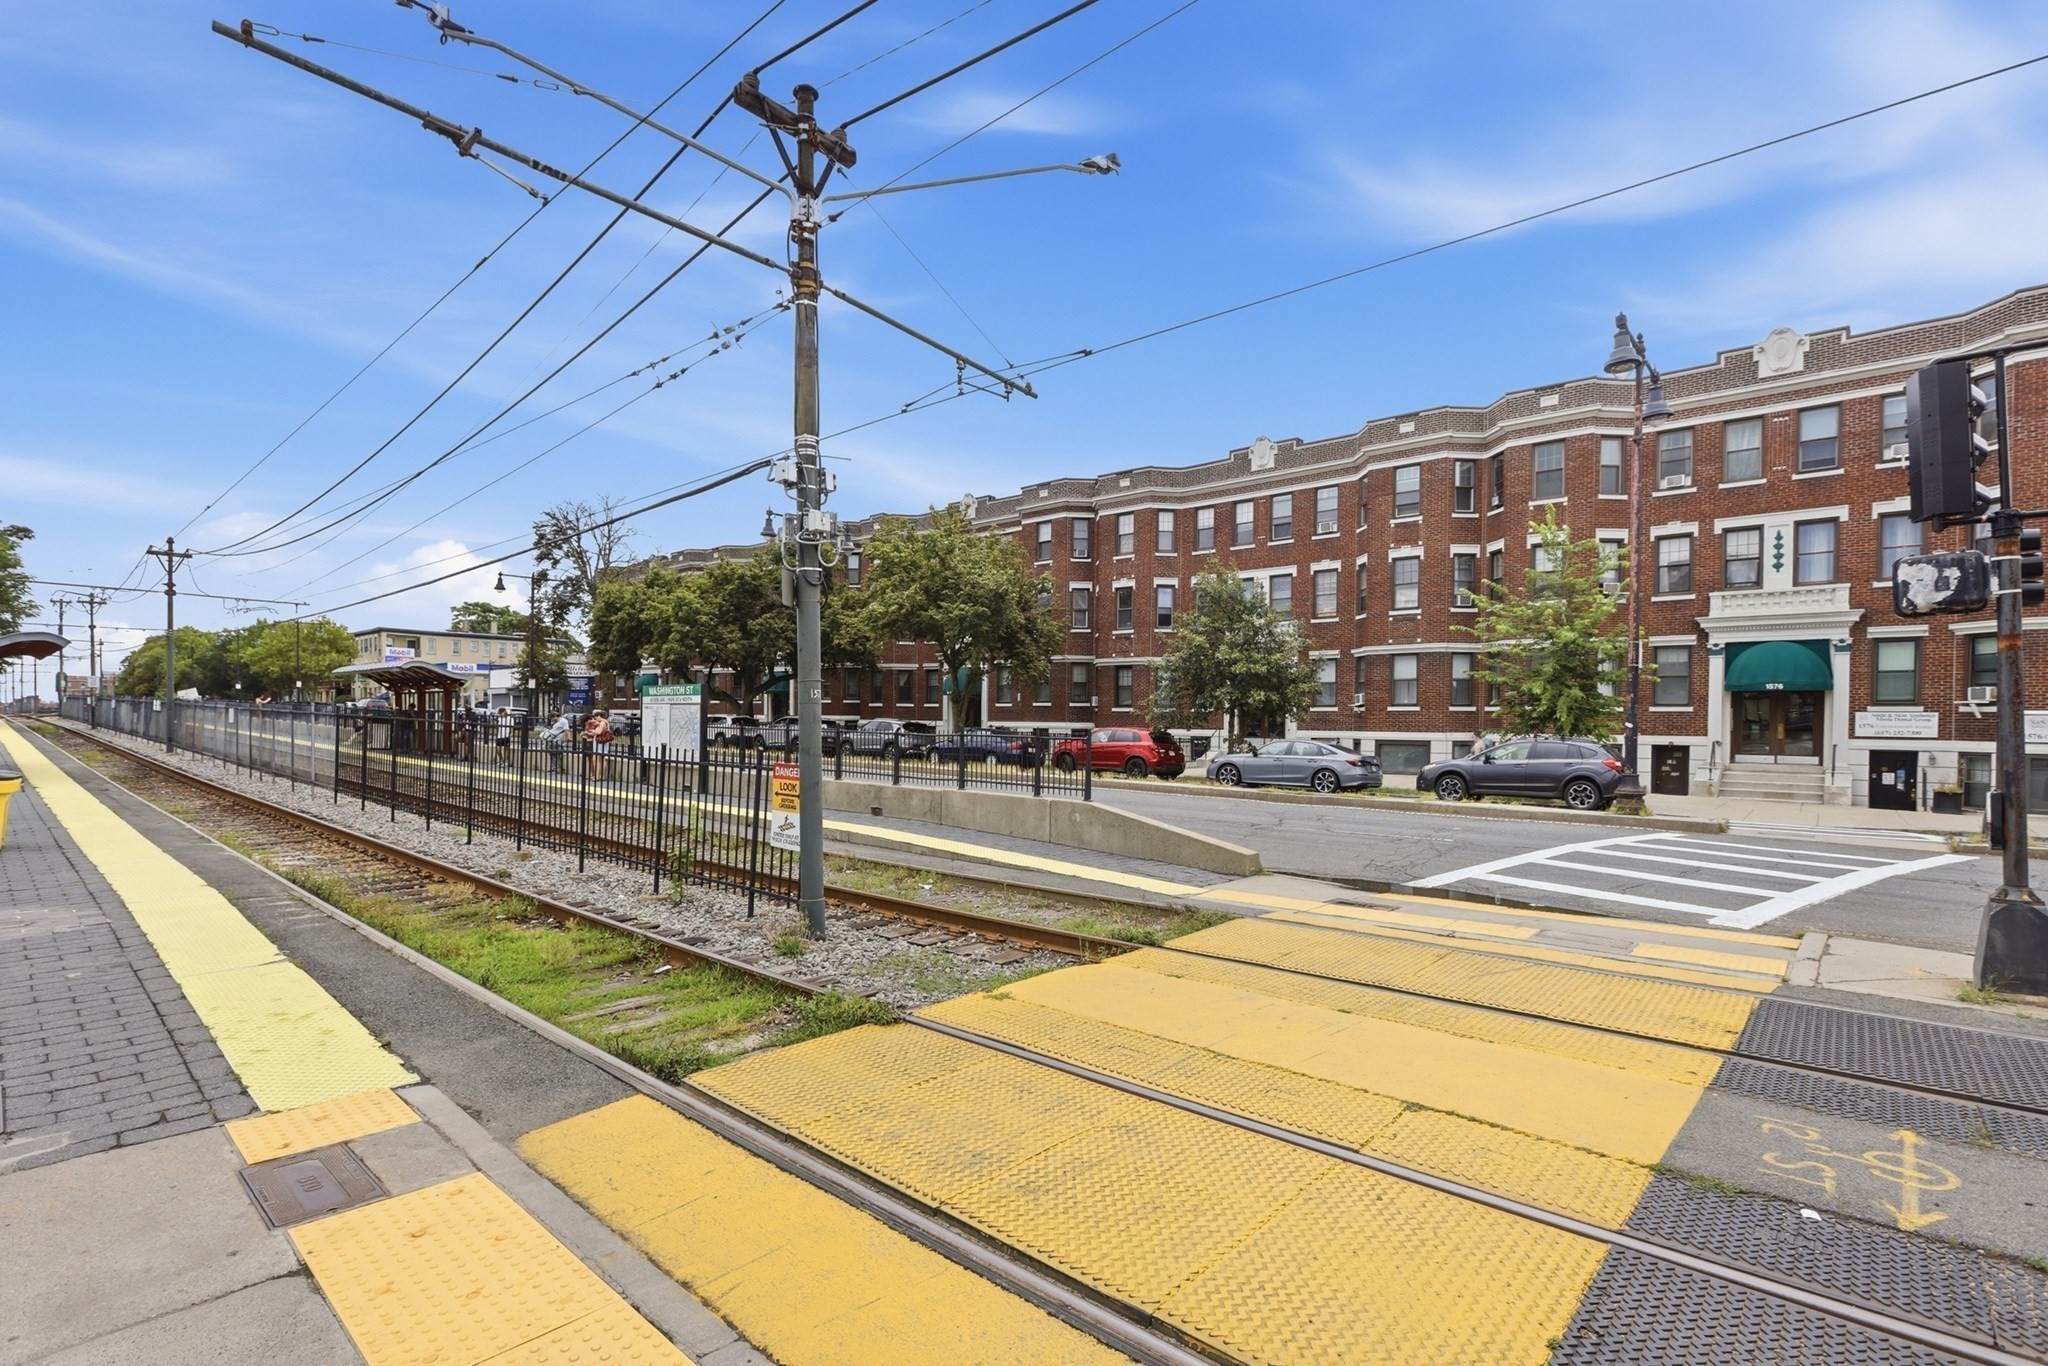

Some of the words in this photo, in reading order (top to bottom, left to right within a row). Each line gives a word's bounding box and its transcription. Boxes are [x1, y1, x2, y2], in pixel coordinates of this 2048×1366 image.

[389, 648, 411, 656] Mobil
[451, 664, 474, 672] Mobil
[649, 687, 685, 695] WASHINGTON
[686, 686, 694, 694] ST
[780, 782, 797, 792] LOOK
